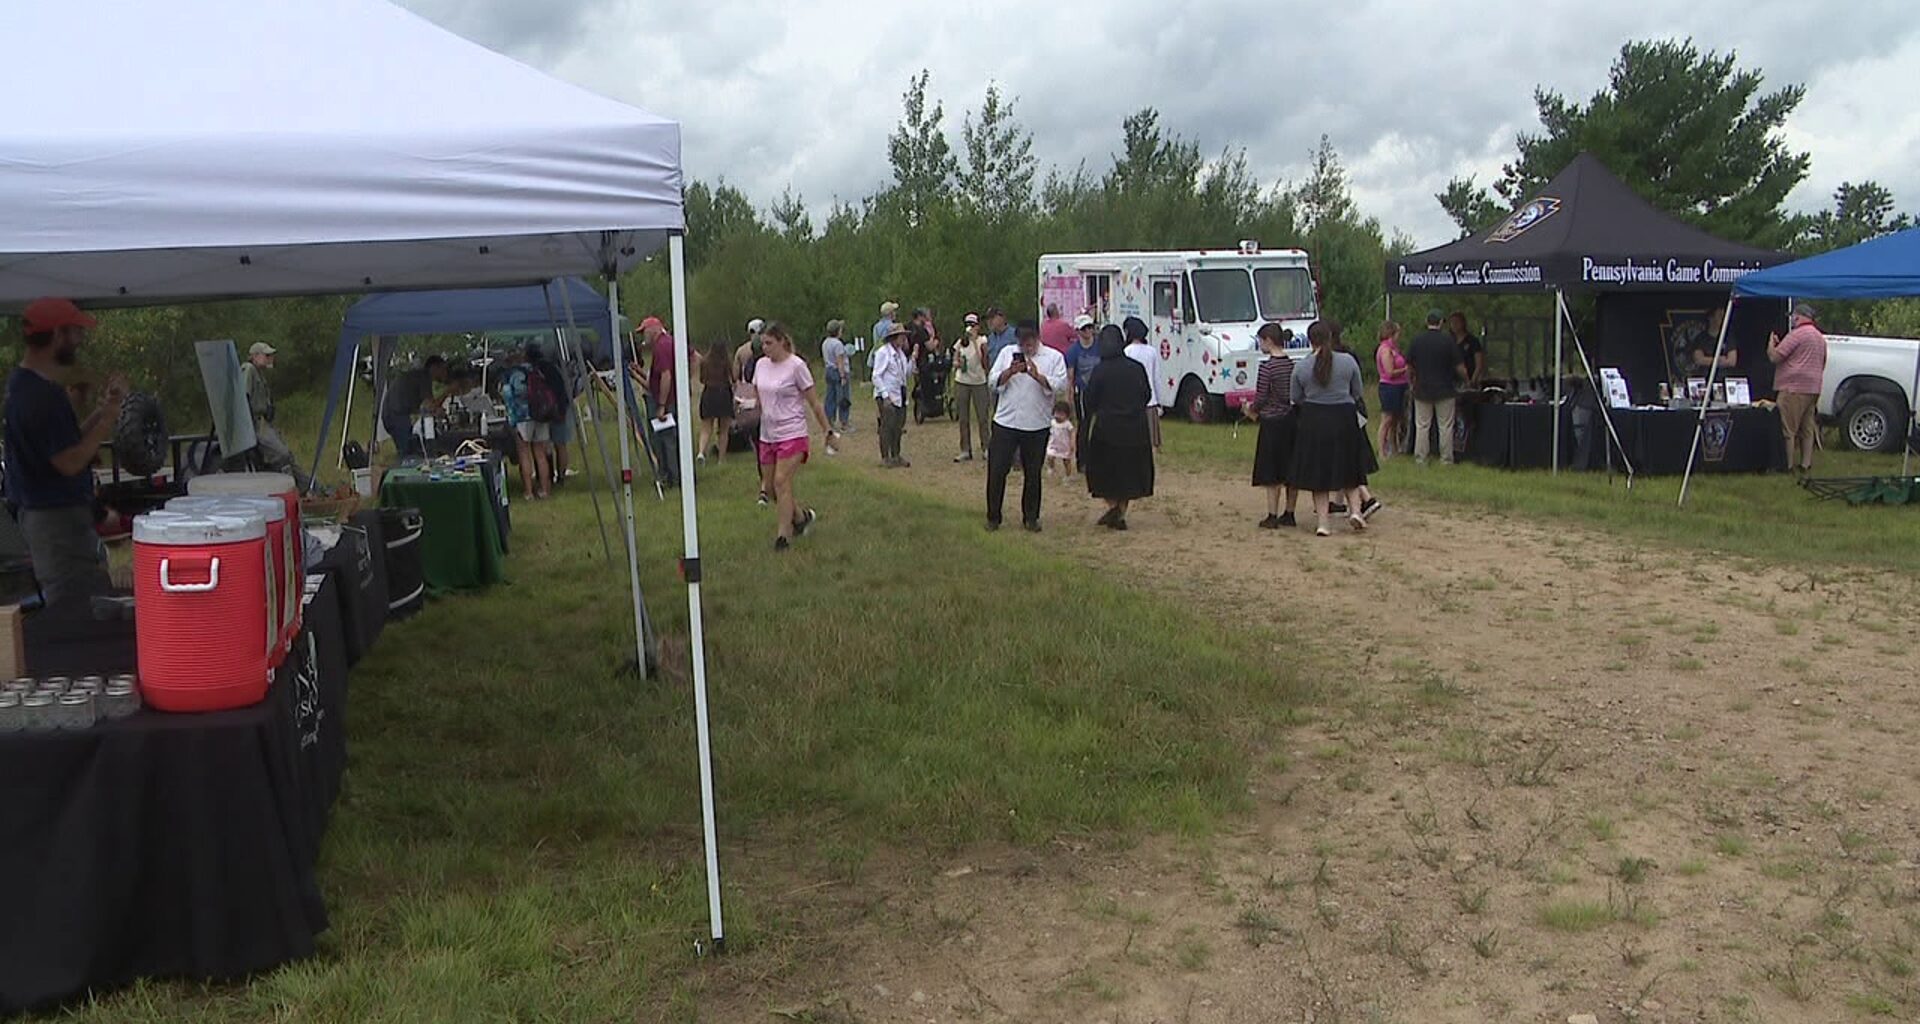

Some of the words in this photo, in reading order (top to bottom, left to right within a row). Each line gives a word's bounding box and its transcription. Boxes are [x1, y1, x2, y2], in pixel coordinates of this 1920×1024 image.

[1399, 265, 1454, 289] Pennsylvania
[1455, 263, 1481, 285] Game
[1482, 260, 1541, 284] Commission
[1582, 257, 1663, 285] Pennsylvania
[1666, 258, 1700, 283] Game
